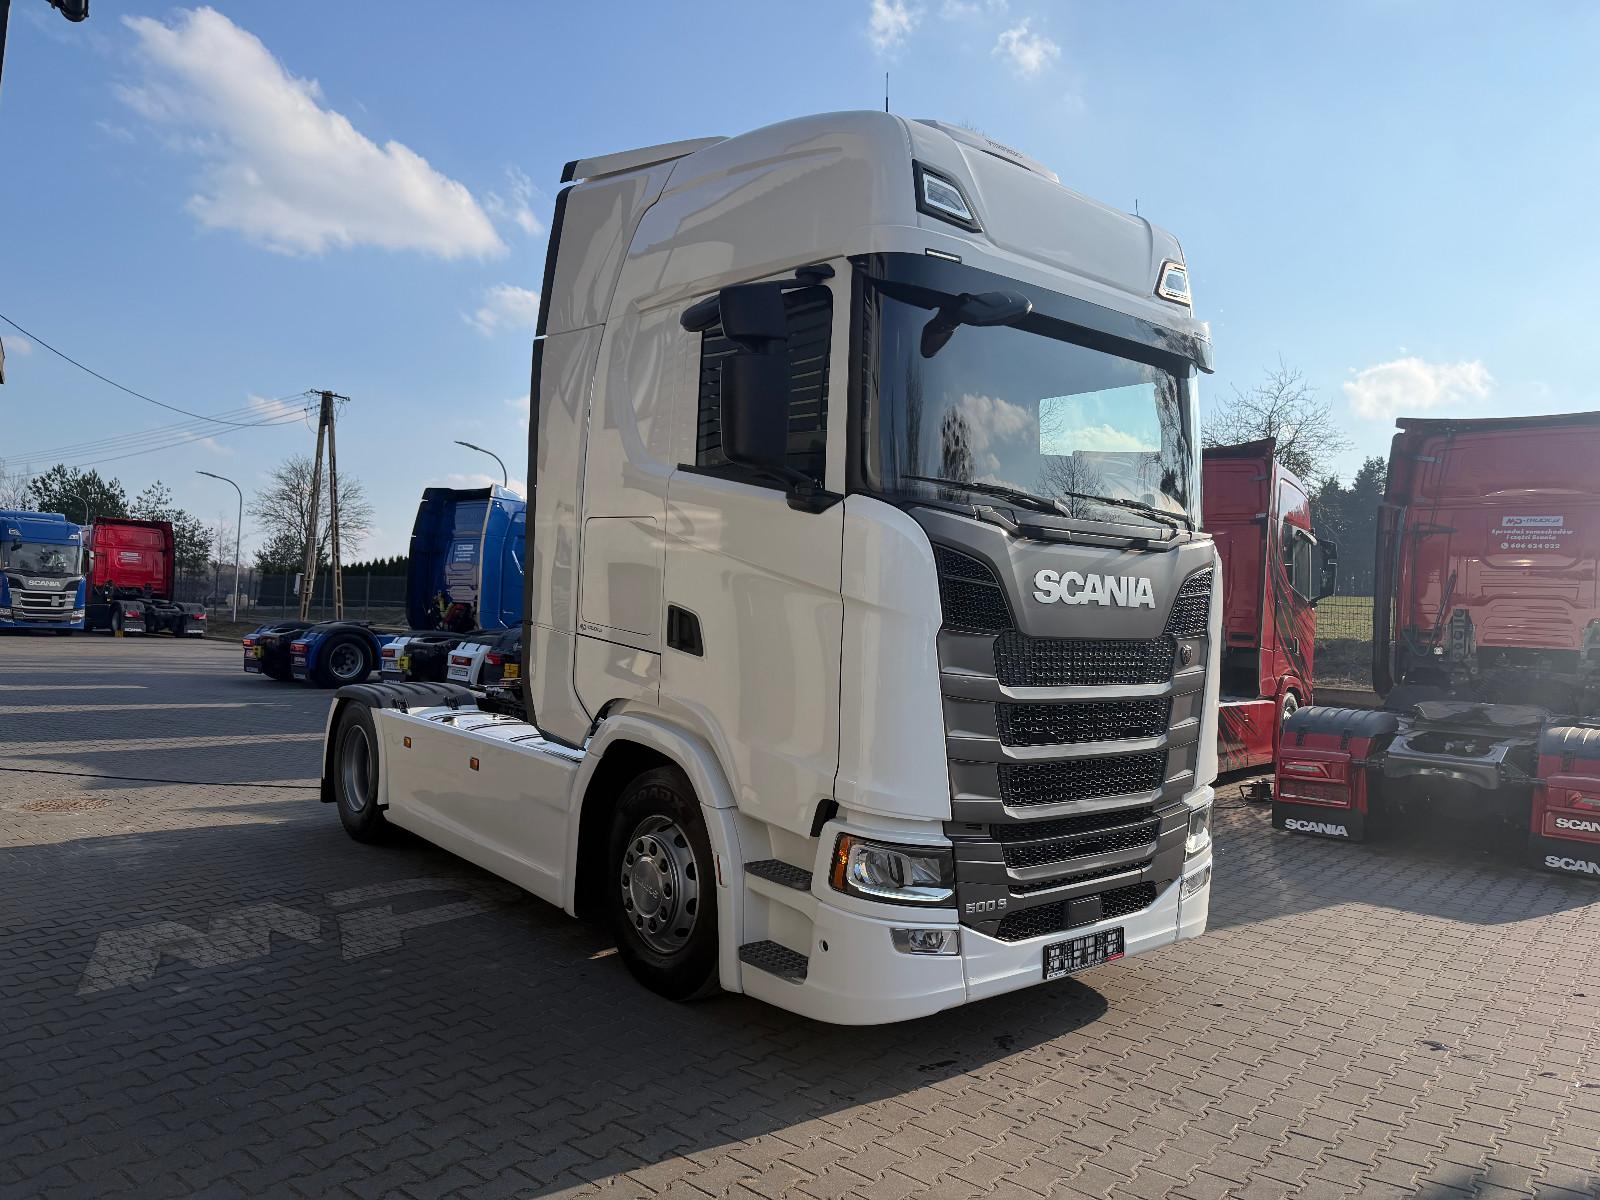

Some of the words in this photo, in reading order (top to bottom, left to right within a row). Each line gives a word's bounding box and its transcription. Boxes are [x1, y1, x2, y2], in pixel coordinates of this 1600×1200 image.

[1032, 569, 1156, 608] SCANIA
[1284, 818, 1348, 837] SCANIA
[965, 900, 996, 913] 500
